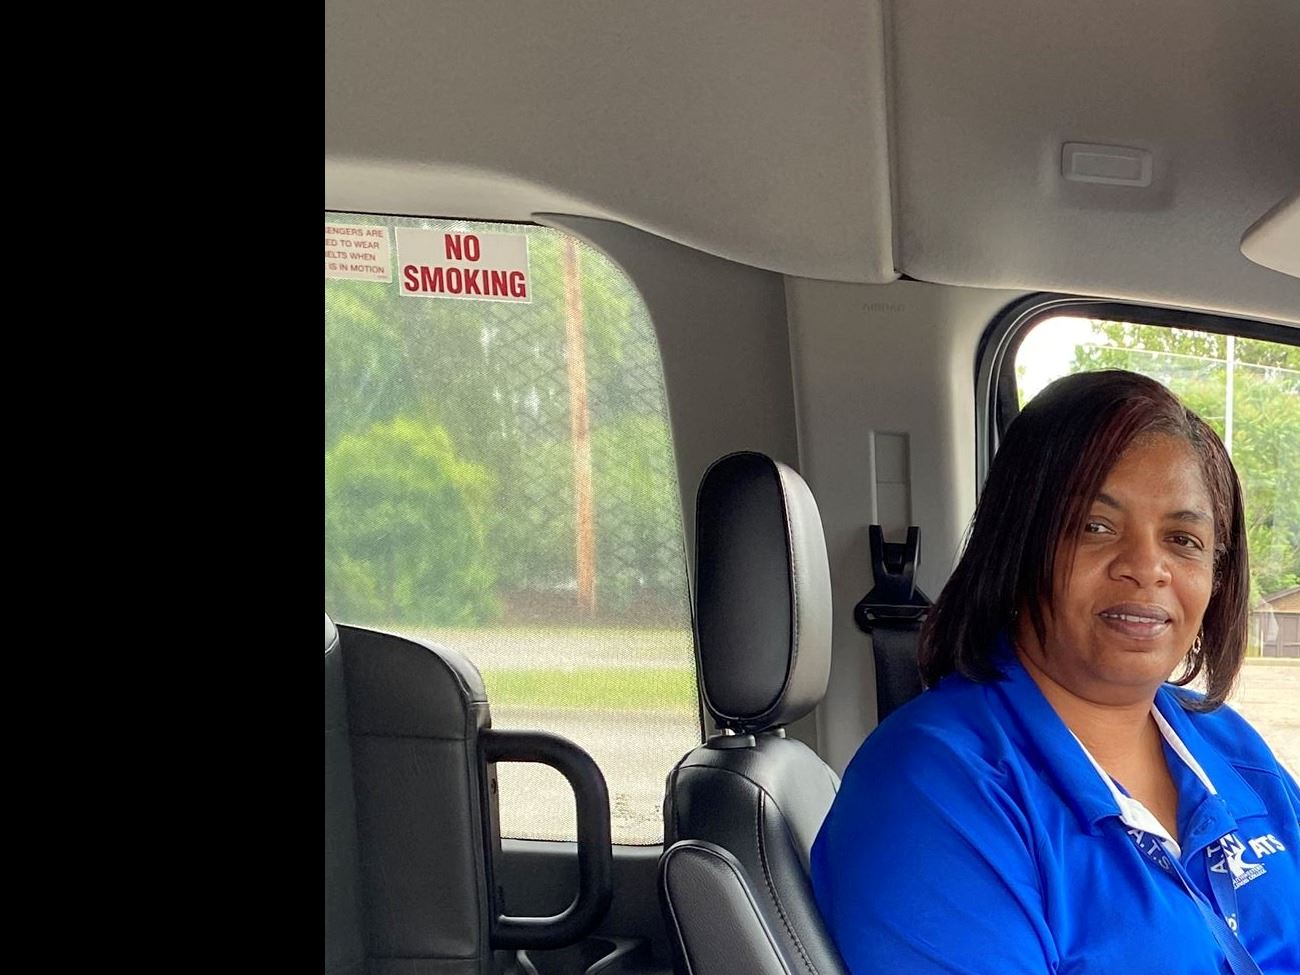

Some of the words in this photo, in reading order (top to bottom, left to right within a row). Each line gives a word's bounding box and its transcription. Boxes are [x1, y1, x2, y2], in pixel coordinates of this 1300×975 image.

[366, 229, 384, 238] ARE
[340, 240, 352, 248] TO
[353, 241, 380, 249] WEAR
[444, 233, 480, 262] NO
[349, 252, 376, 261] WHEN
[350, 264, 385, 273] MOTION
[404, 265, 526, 297] SMOKING
